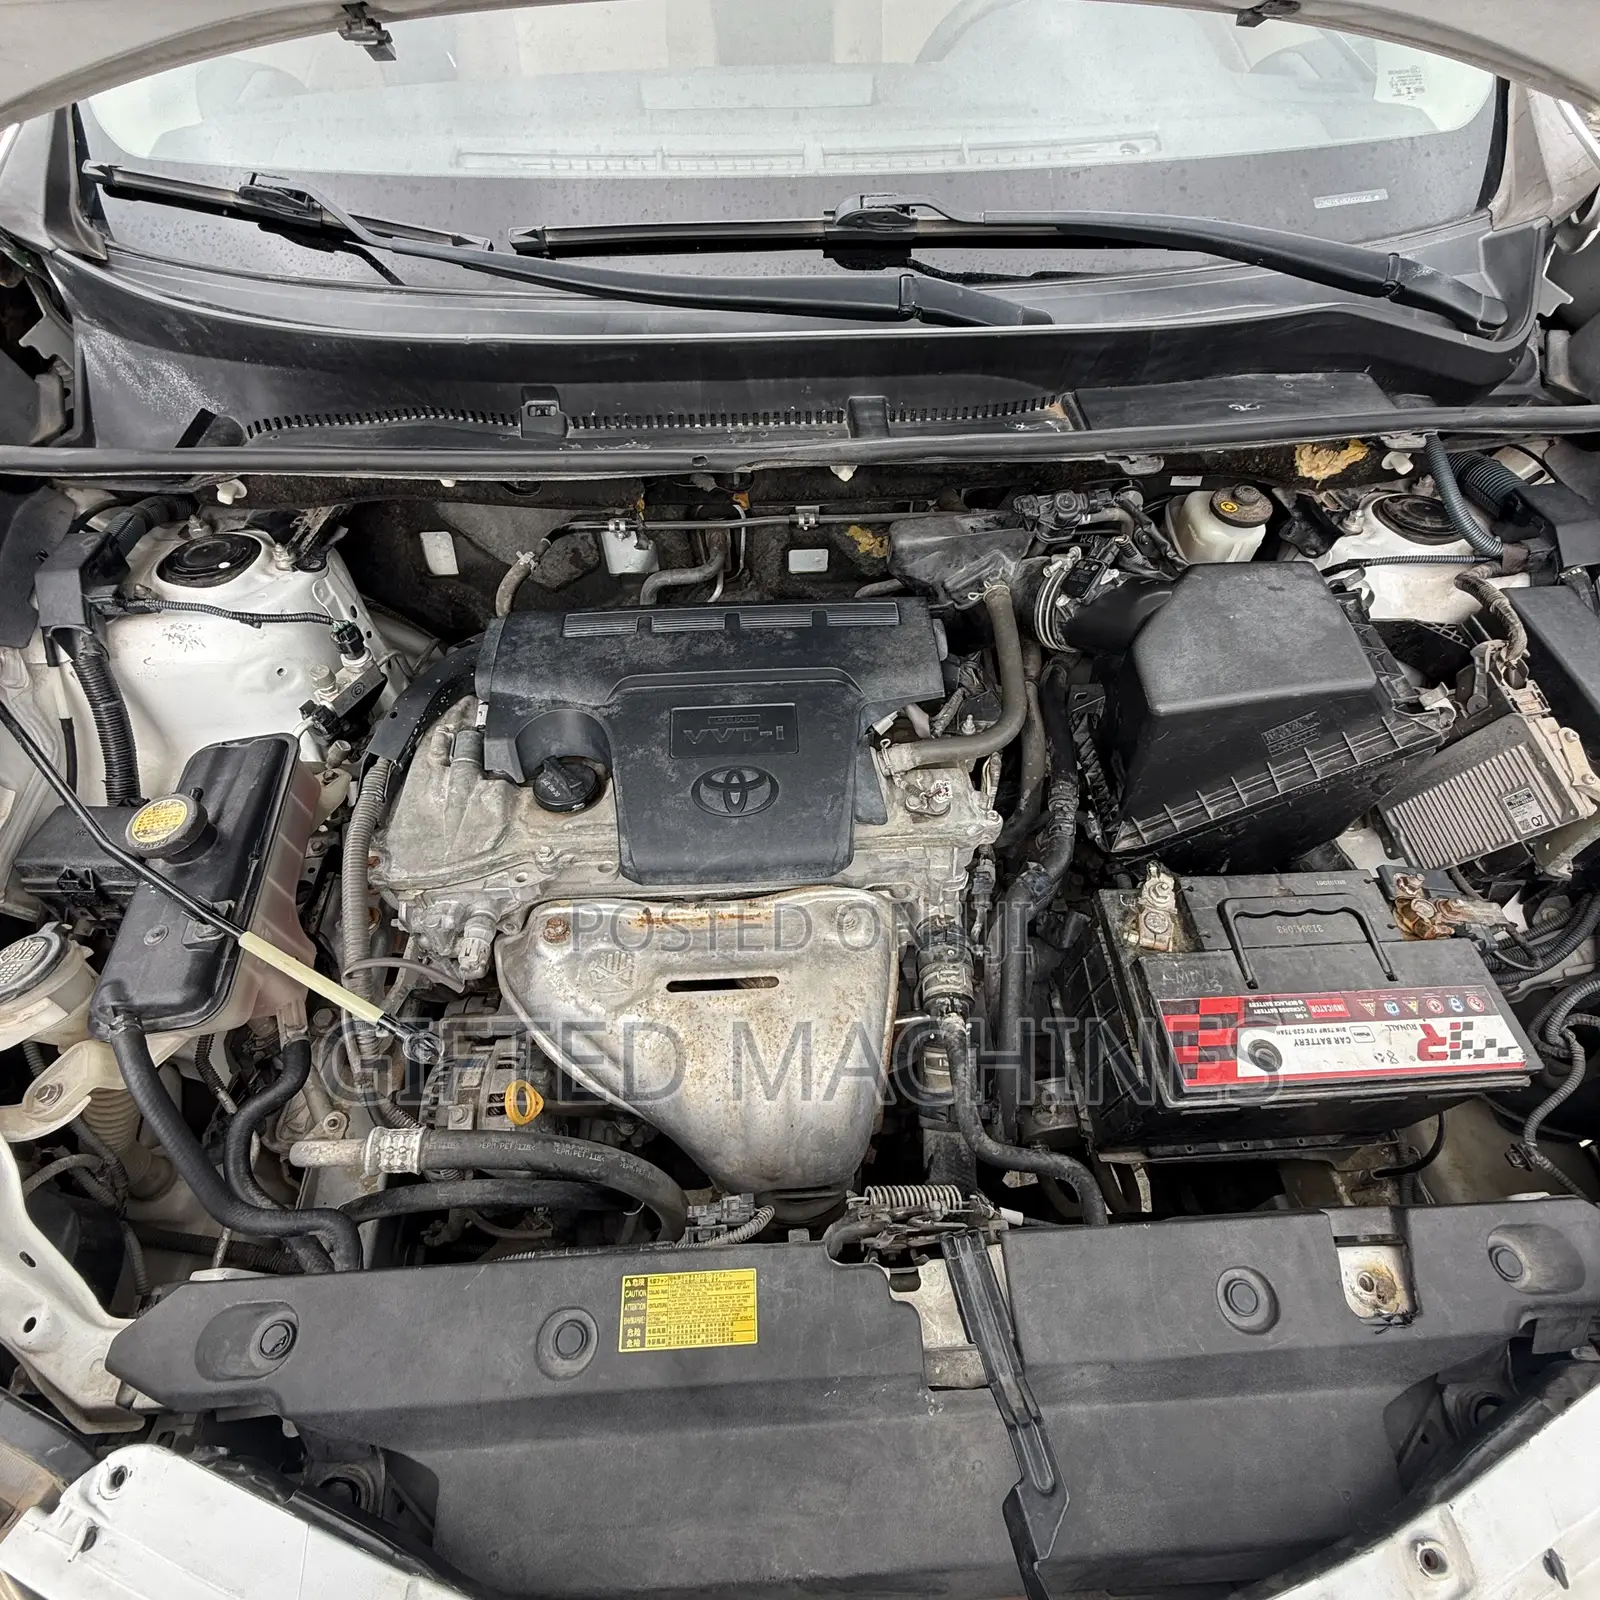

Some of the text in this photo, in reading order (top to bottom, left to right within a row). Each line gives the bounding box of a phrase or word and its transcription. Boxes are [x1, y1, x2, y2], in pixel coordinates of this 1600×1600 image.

[1531, 815, 1544, 827] Q7
[1310, 1003, 1345, 1013] INDICATOR
[1385, 1023, 1417, 1032] RUNALL
[1293, 1036, 1351, 1047] CAR BATTERY
[625, 1289, 647, 1298] CAUTION
[624, 1303, 646, 1311] ATTENTION
